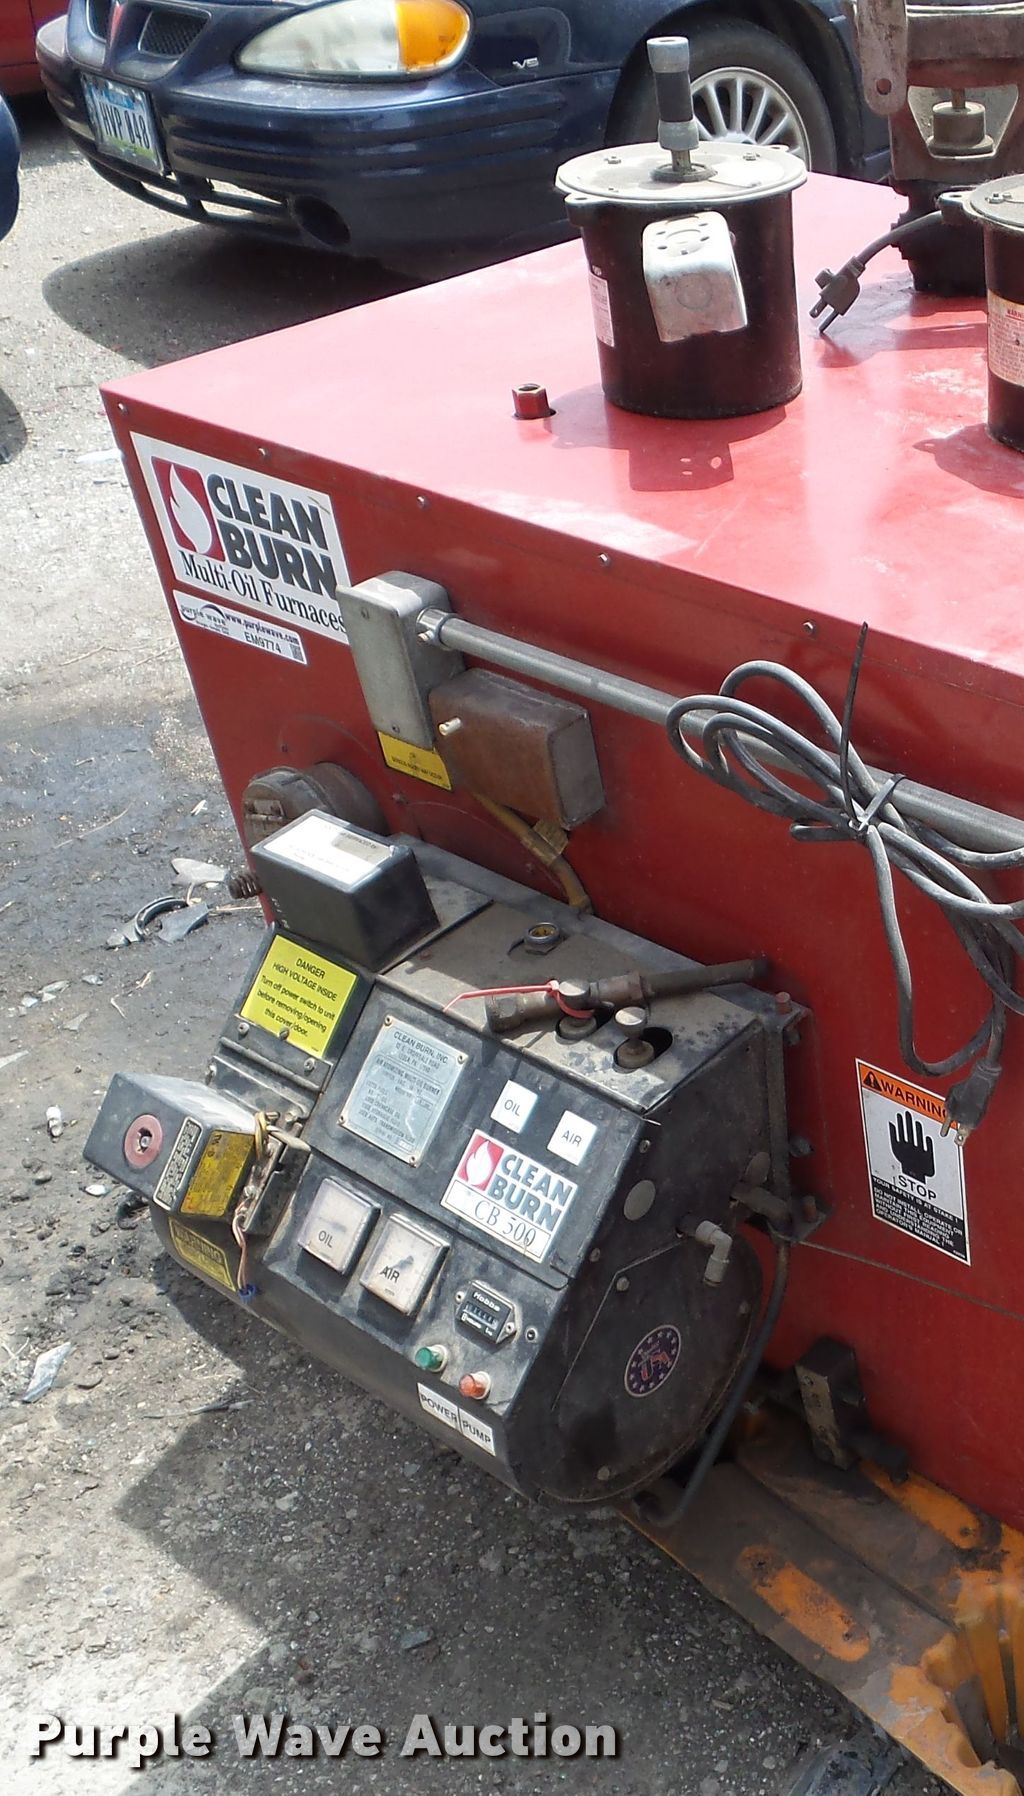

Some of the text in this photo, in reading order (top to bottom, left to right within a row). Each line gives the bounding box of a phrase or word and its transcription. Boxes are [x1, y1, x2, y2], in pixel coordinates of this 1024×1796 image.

[207, 473, 329, 550] CLEAN
[217, 519, 338, 600] BURN
[178, 550, 347, 633] Multi-Oil Furnaces
[244, 631, 282, 654] EM9774
[272, 961, 337, 1001] HIGH VOLTAGE INSIDE
[295, 957, 326, 979] DANGER
[256, 989, 327, 1032] before removing/opening
[260, 975, 335, 1020] Turn off power switch to unit
[264, 1007, 309, 1036] this cover/door.
[393, 1030, 415, 1047] CLEAN
[504, 1099, 521, 1117] OIL
[561, 1130, 582, 1147] AIR
[501, 1153, 573, 1207] CLEAN
[873, 1176, 889, 1188] YOUR
[891, 1186, 914, 1201] SAFETY
[923, 1202, 931, 1210] AT
[933, 1206, 952, 1220] STAKE
[898, 1175, 937, 1201] STOP
[487, 1174, 563, 1232] BURN
[874, 1187, 882, 1195] DO
[883, 1191, 895, 1202] NOT
[923, 1212, 951, 1229] OPERATE
[953, 1227, 962, 1235] OR
[874, 1192, 953, 1236] MAINTAIN THIS EQUIPMENT
[875, 1198, 949, 1239] WITHOUT FIRST READING
[318, 1230, 333, 1248] OIL
[474, 1200, 537, 1248] CB 500
[875, 1203, 953, 1246] AND UNDERSTANDING THE
[914, 1227, 939, 1244] MANUAL
[380, 1265, 401, 1283] AIR
[420, 1393, 457, 1422] POWER
[462, 1420, 491, 1444] PUMP
